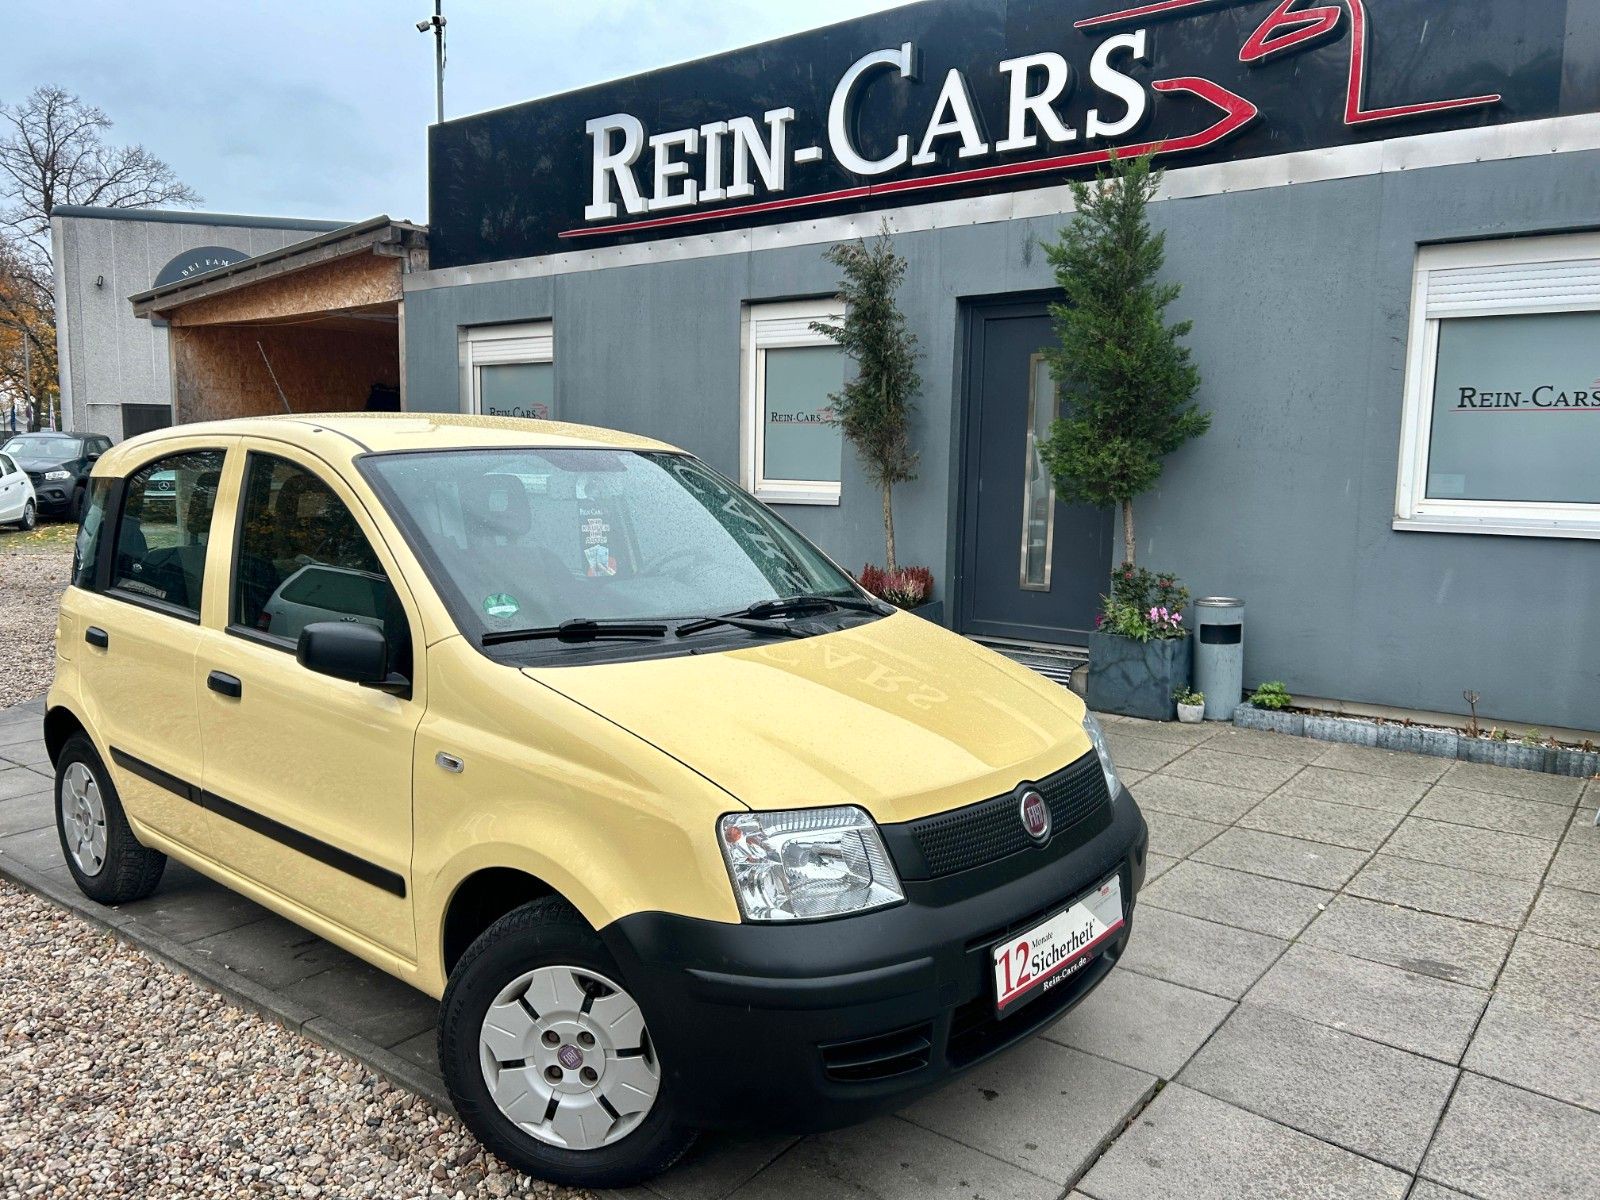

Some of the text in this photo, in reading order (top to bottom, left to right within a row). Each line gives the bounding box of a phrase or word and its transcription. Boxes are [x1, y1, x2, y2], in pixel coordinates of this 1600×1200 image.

[584, 28, 1148, 221] REIN-CARS
[181, 262, 200, 276] BEI
[1026, 803, 1043, 827] FIAT
[998, 931, 1054, 997] 12 Monate
[1043, 957, 1087, 991] Rein-Cars.de
[563, 1050, 579, 1066] FIAT
